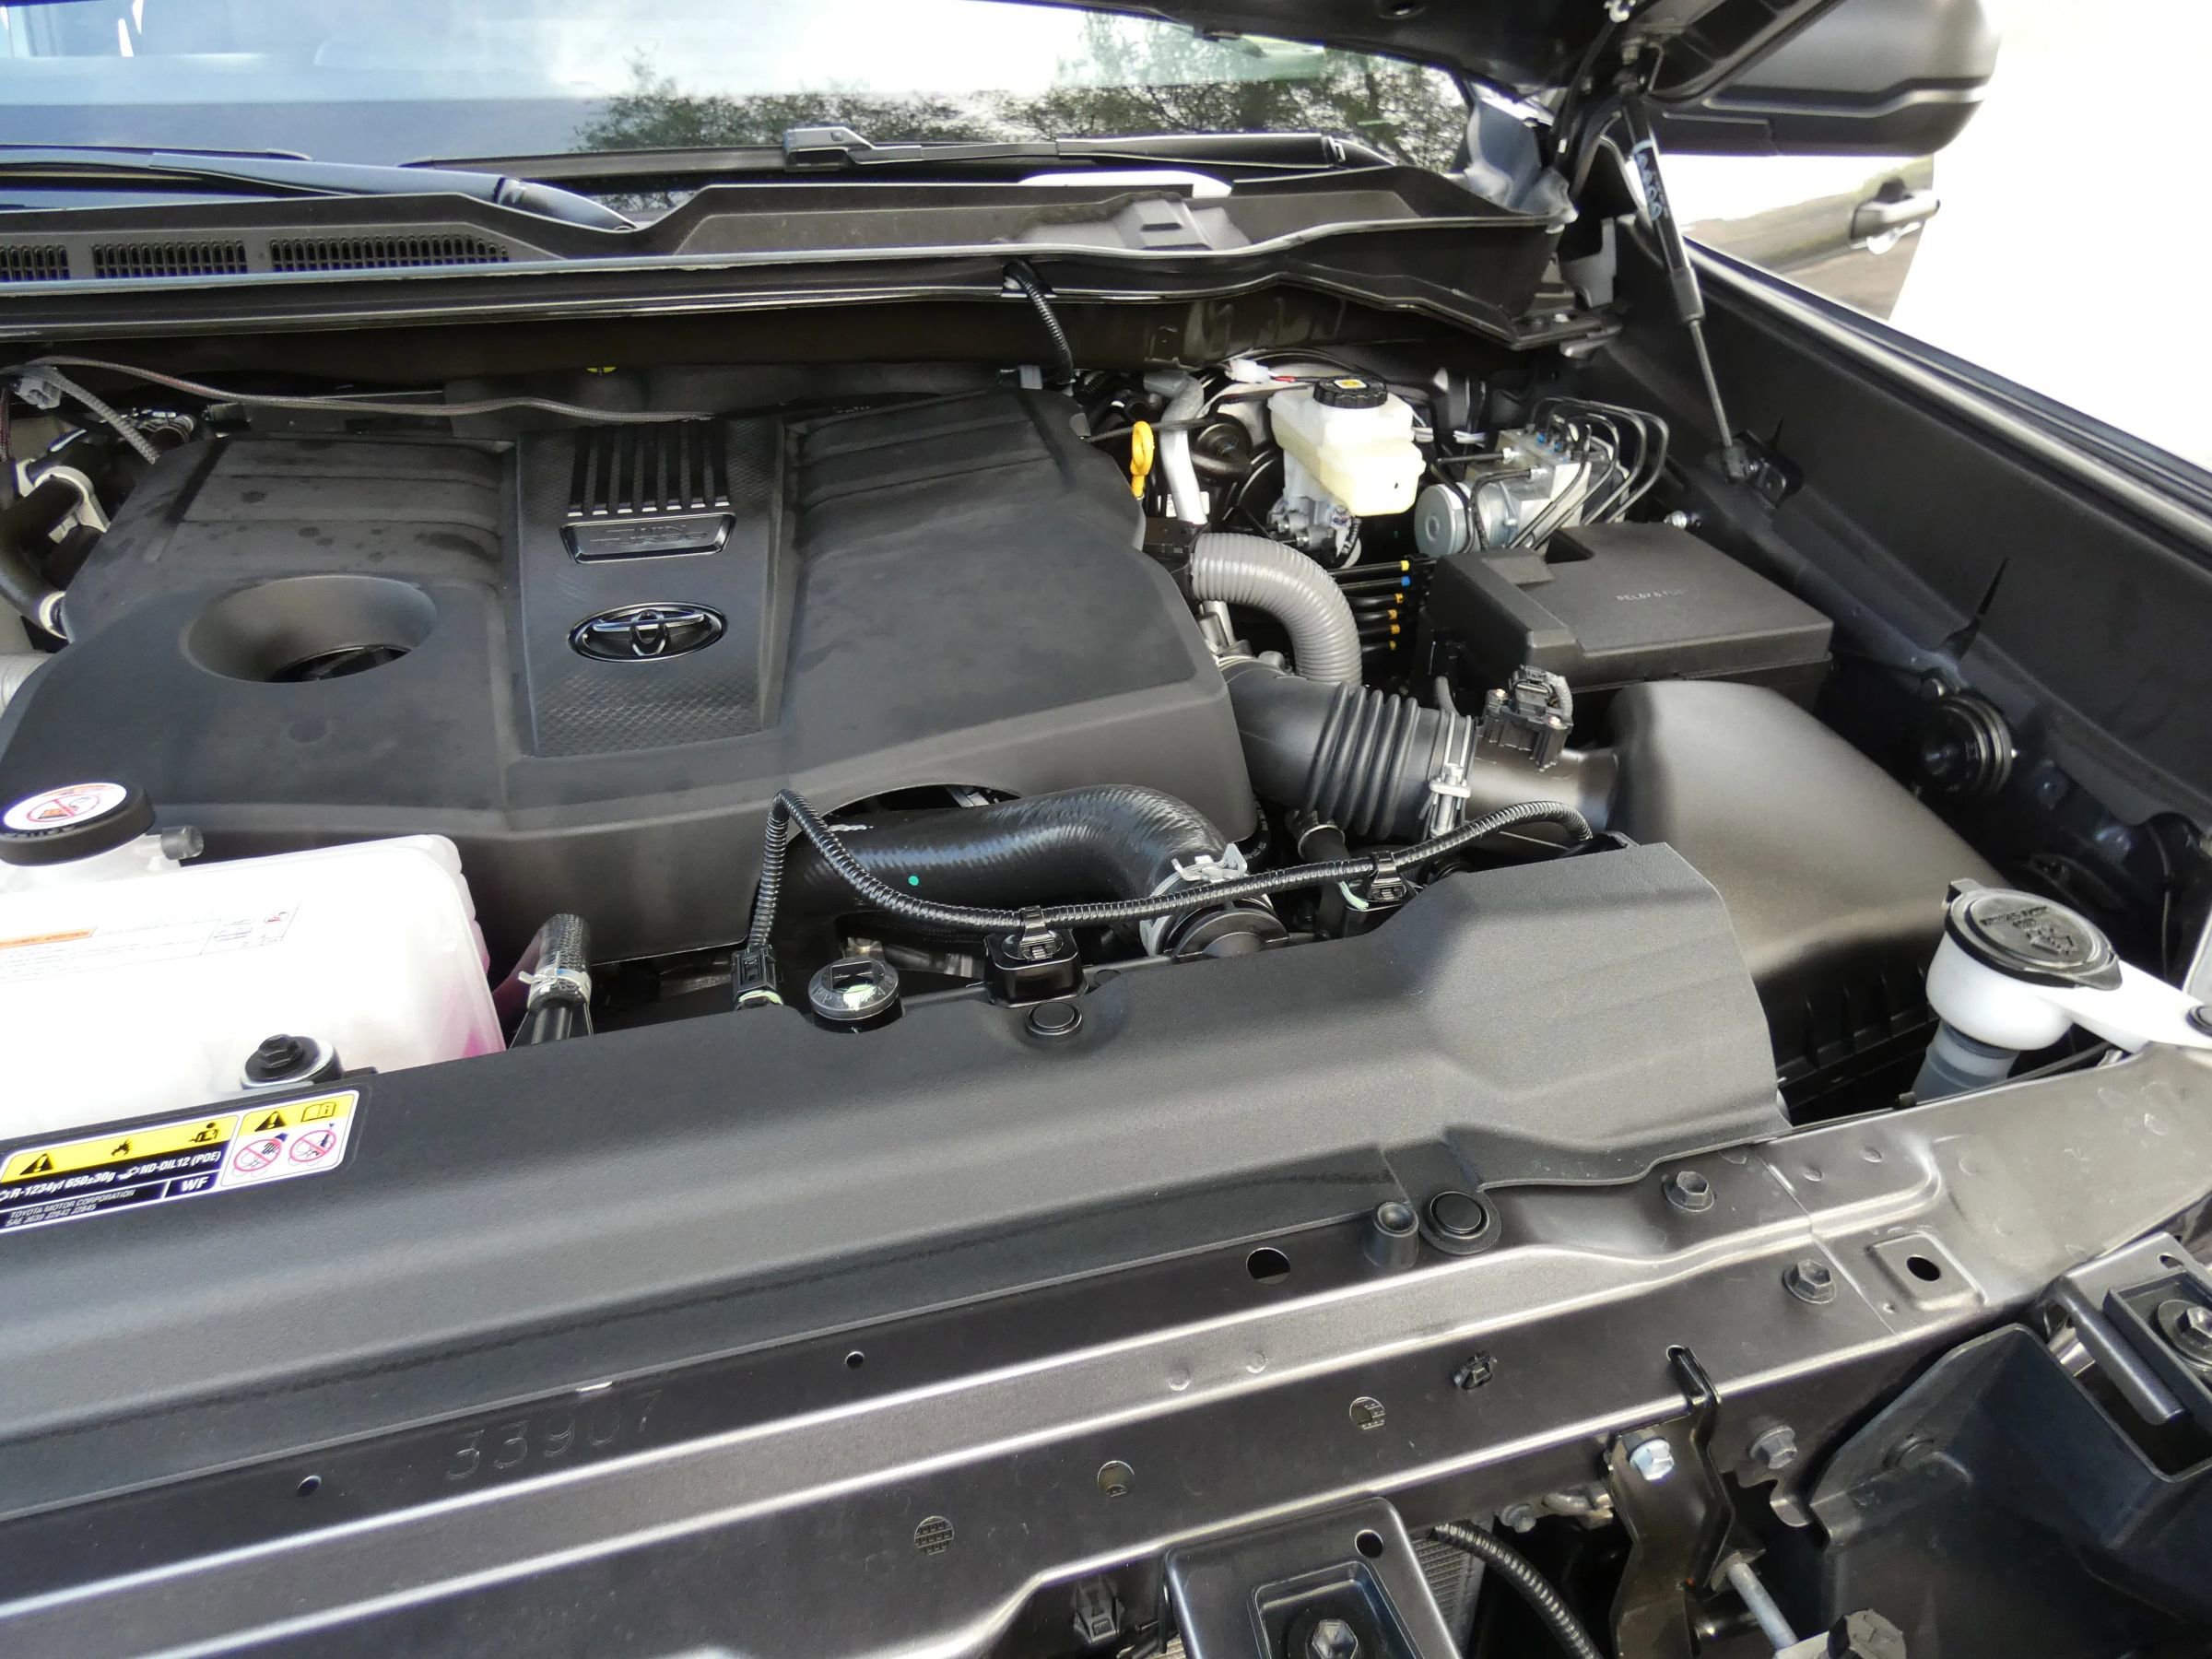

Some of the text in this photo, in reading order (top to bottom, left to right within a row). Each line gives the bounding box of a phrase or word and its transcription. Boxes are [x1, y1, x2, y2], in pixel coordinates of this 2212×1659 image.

[181, 1176, 209, 1192] WF
[10, 1189, 135, 1218] TOYOTA MOTOR CORPORATION
[446, 1389, 663, 1480] 33907
